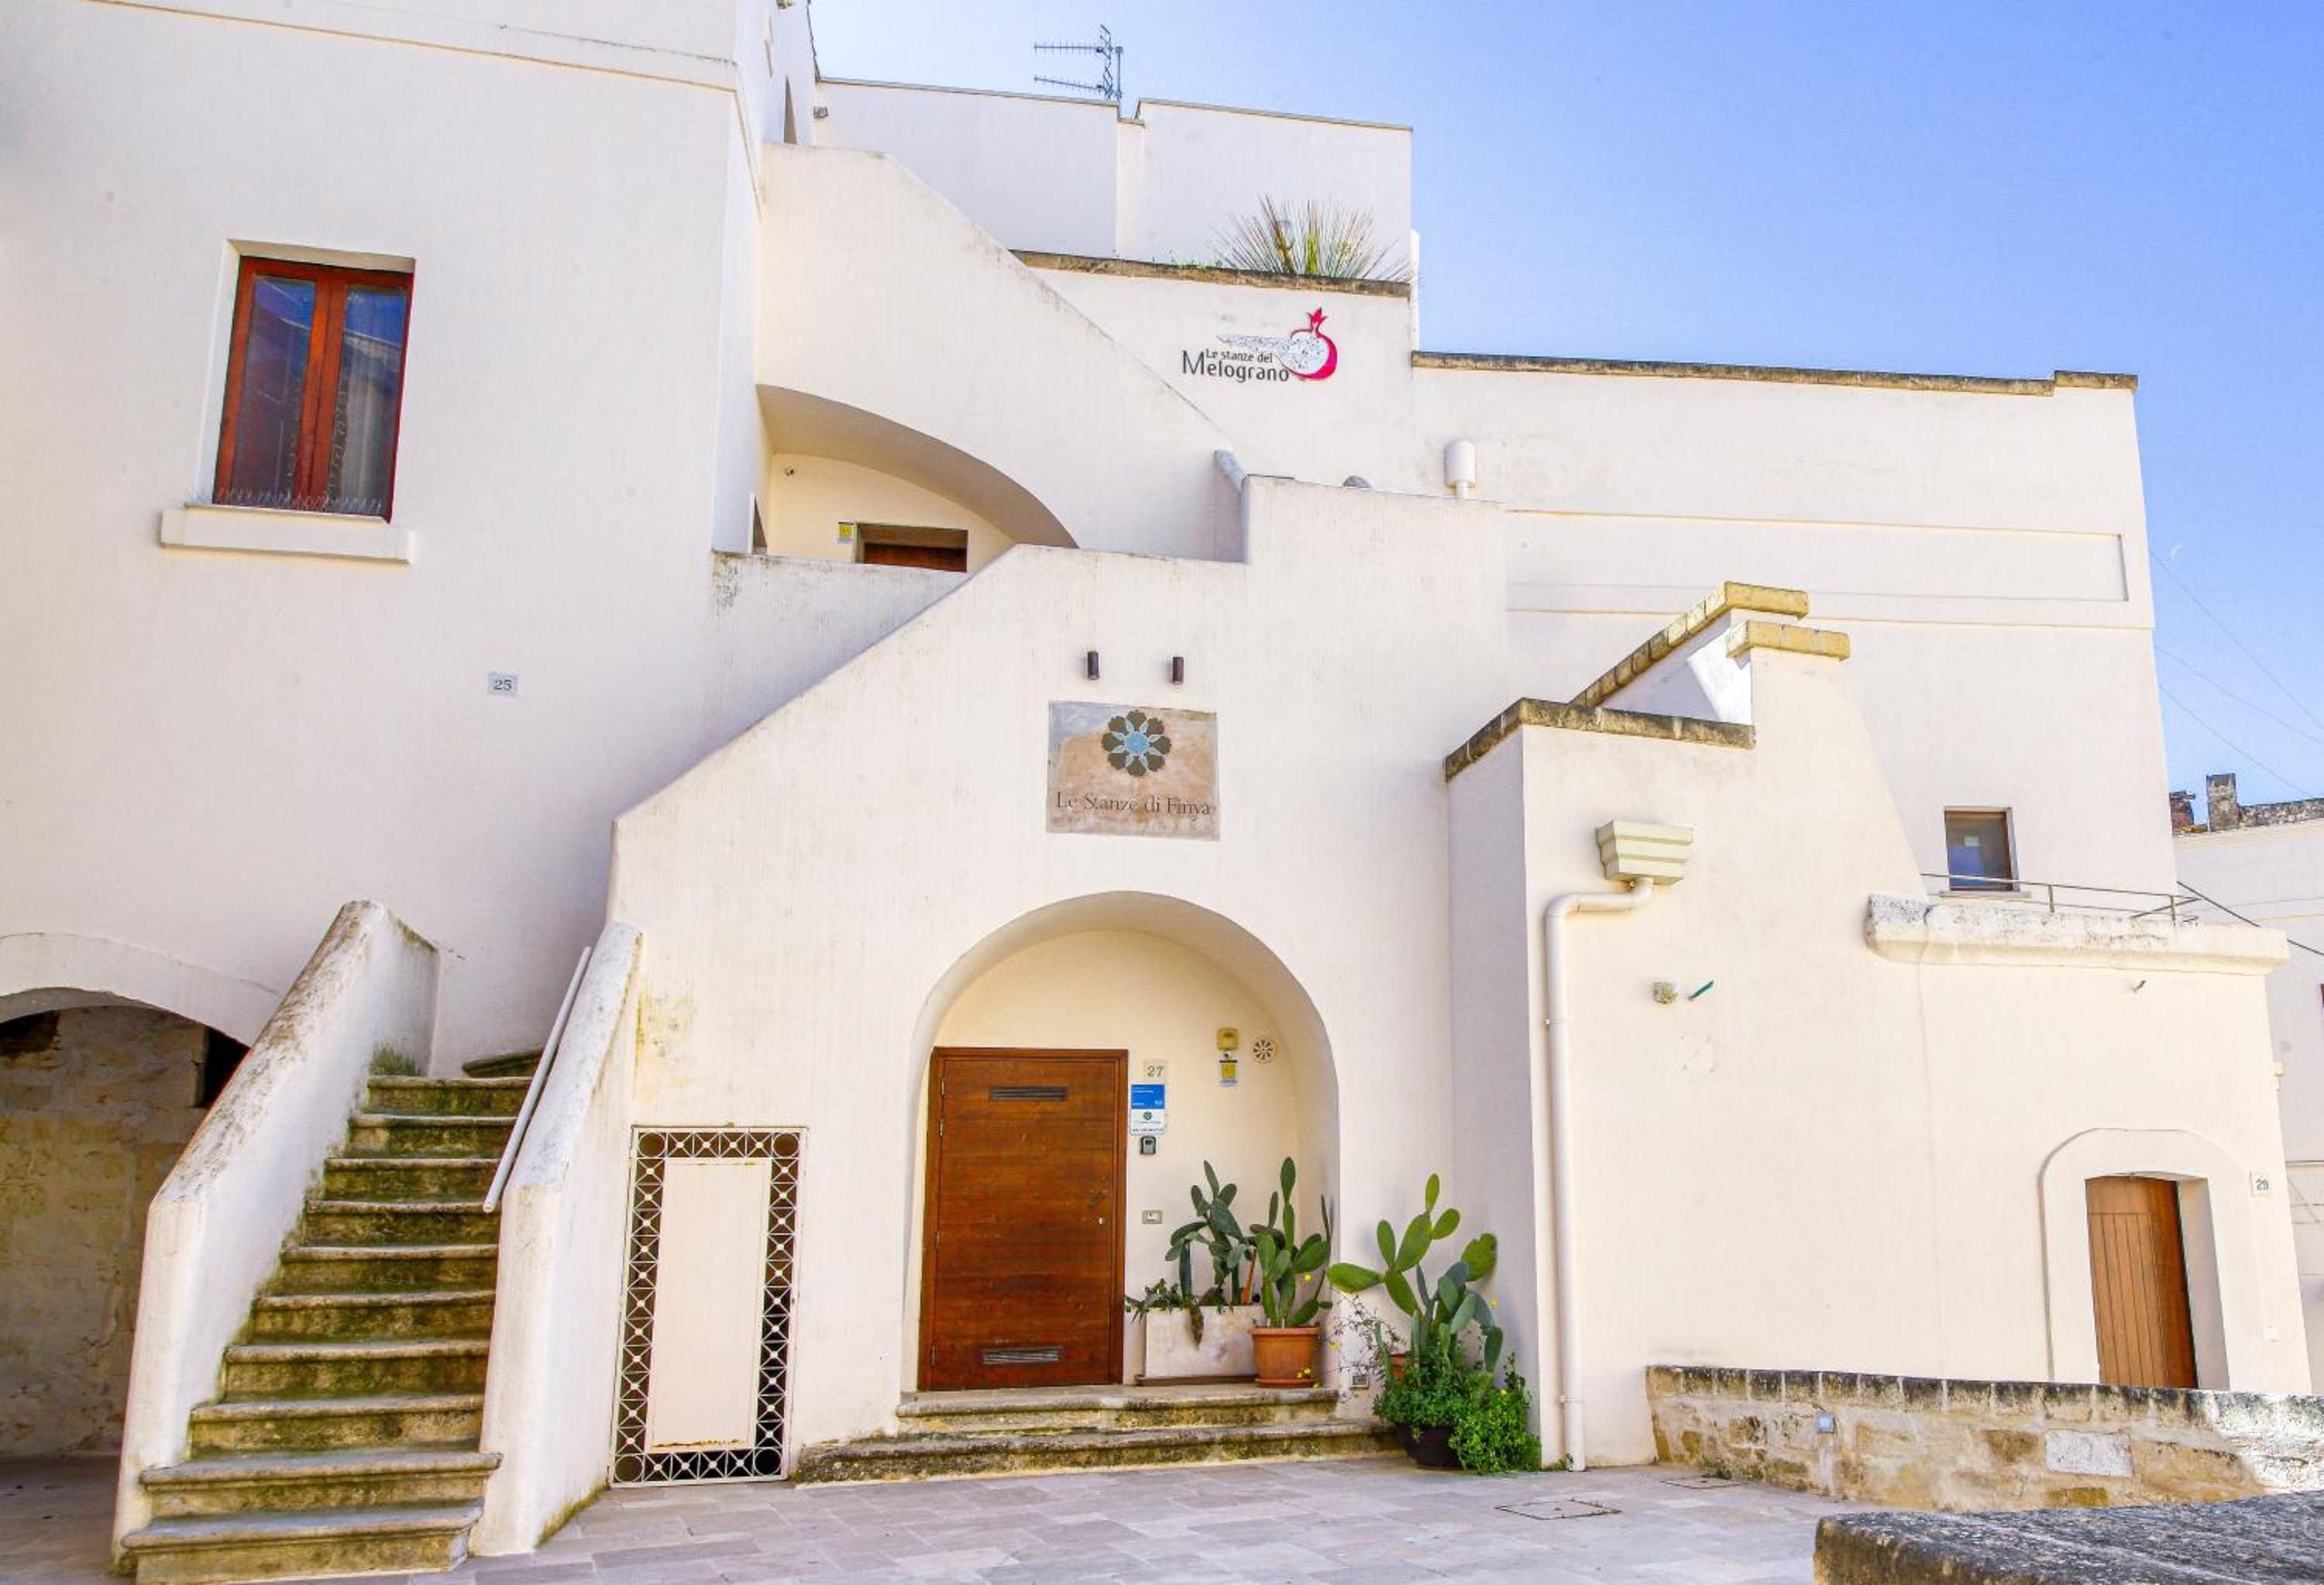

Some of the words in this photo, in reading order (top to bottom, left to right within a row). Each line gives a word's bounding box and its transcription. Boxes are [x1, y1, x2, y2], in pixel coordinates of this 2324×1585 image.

[1205, 348, 1219, 359] Le
[1220, 350, 1254, 362] stanze
[1257, 352, 1273, 363] del
[1181, 349, 1290, 383] Melograno
[493, 679, 512, 691] 25
[1055, 791, 1077, 808] Le
[1083, 792, 1136, 812] Stanze
[1143, 795, 1160, 813] di
[1147, 1065, 1164, 1078] 27
